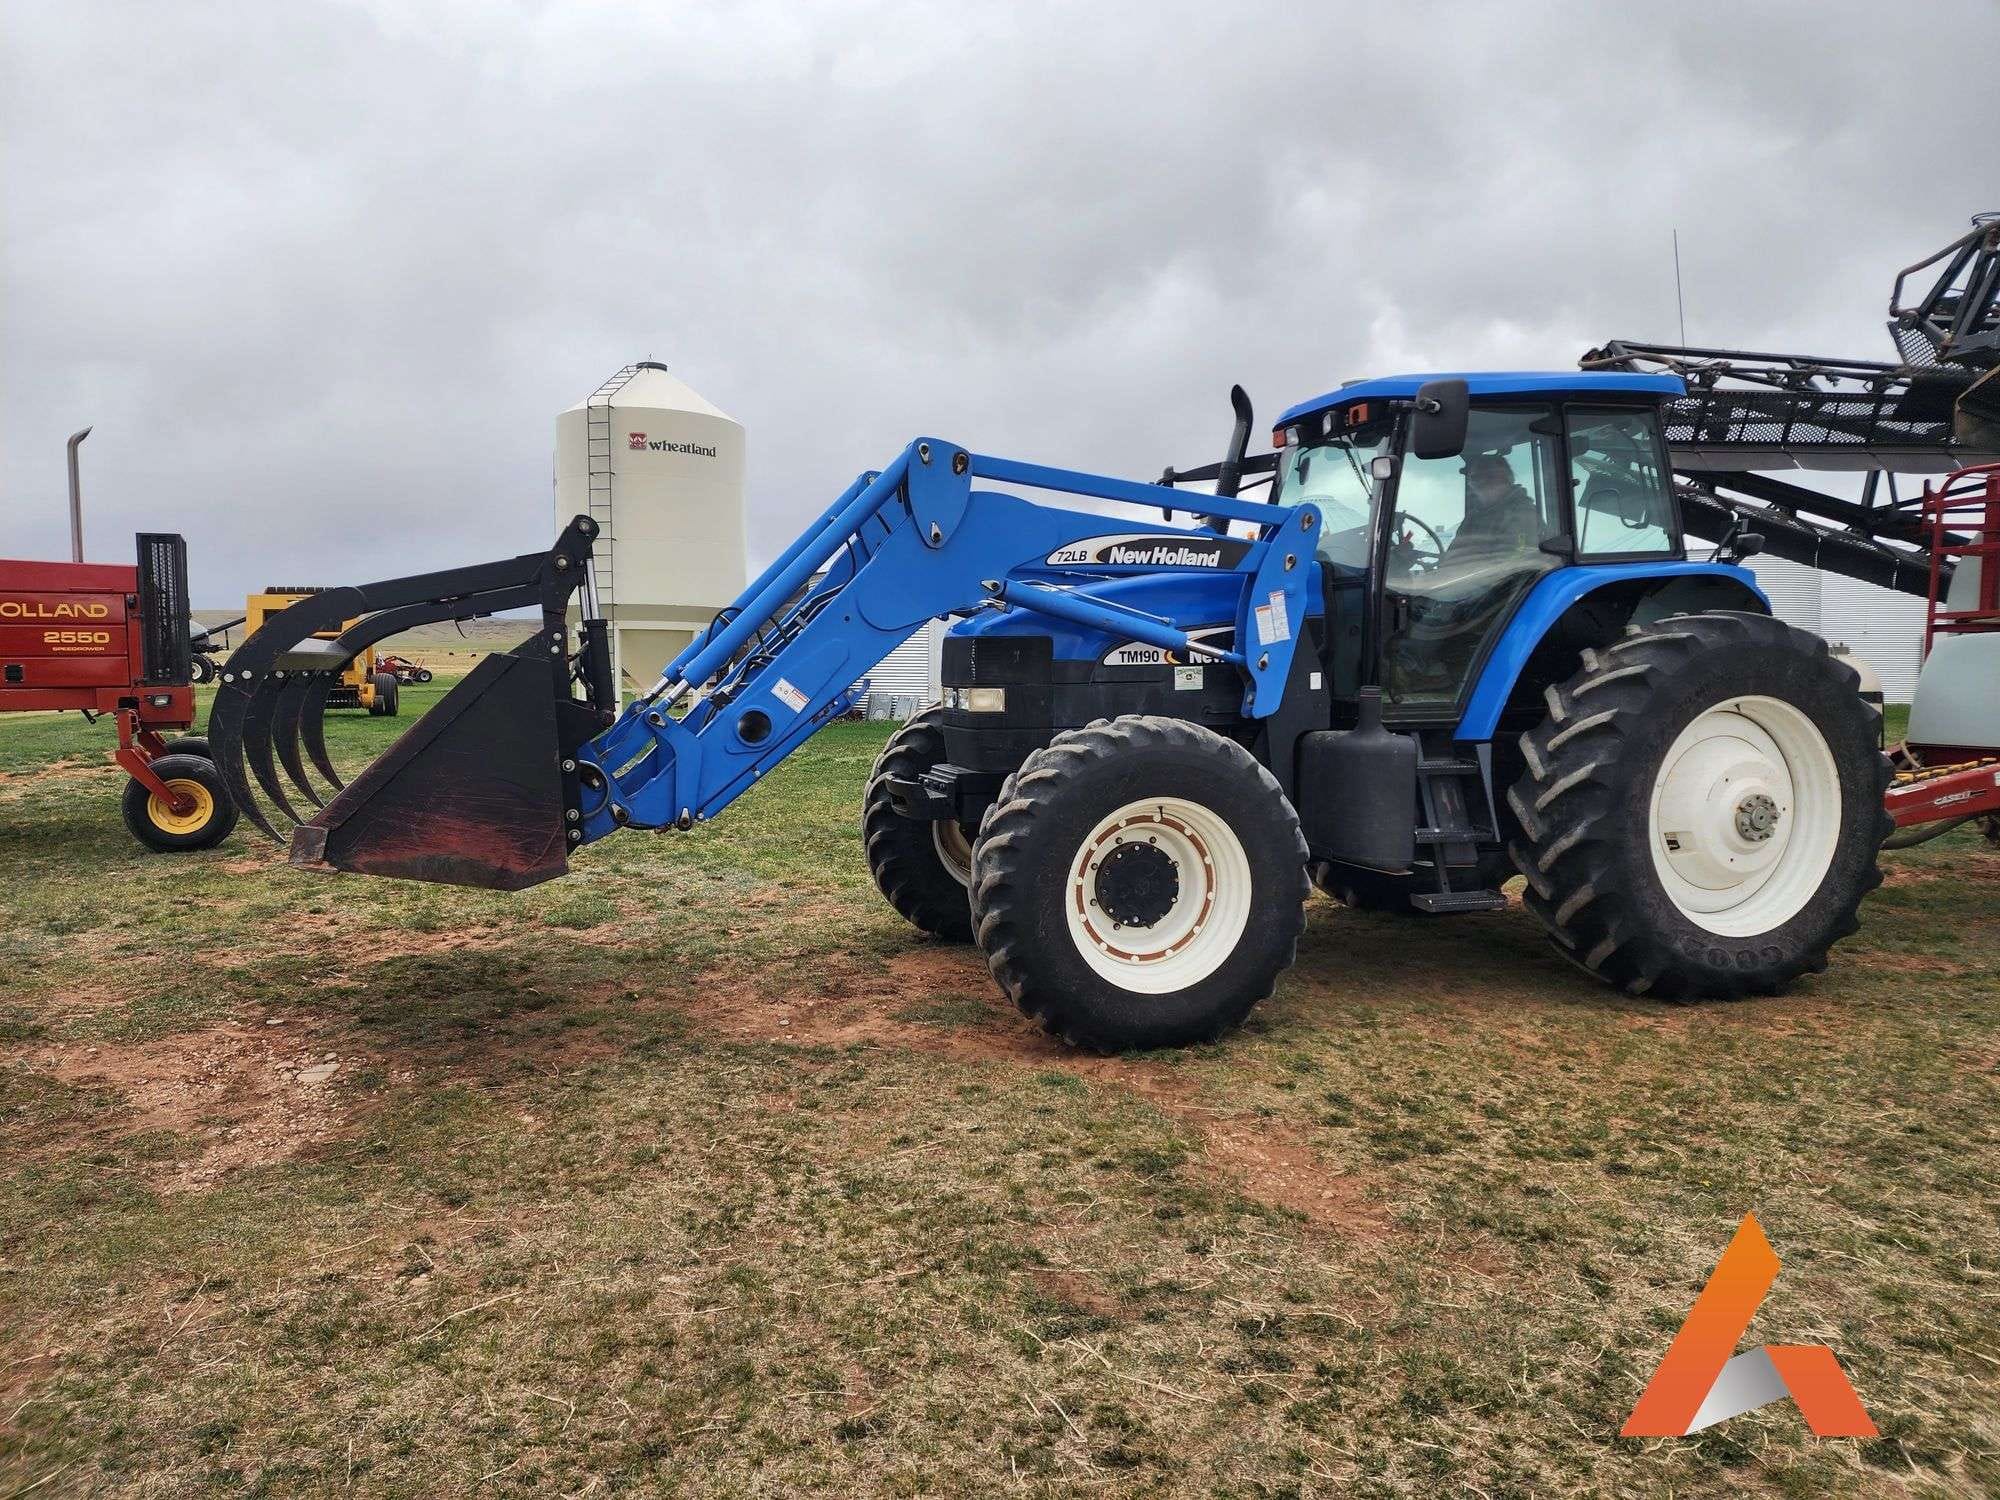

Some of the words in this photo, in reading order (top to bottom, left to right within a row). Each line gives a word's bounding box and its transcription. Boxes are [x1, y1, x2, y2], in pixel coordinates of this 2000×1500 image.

[648, 440, 717, 458] wheatland
[1057, 551, 1087, 562] 72LB
[1109, 547, 1150, 564] New
[1153, 547, 1220, 567] Holland
[0, 602, 109, 618] OLLAND
[44, 631, 110, 644] 2550
[1119, 650, 1159, 663] TM190
